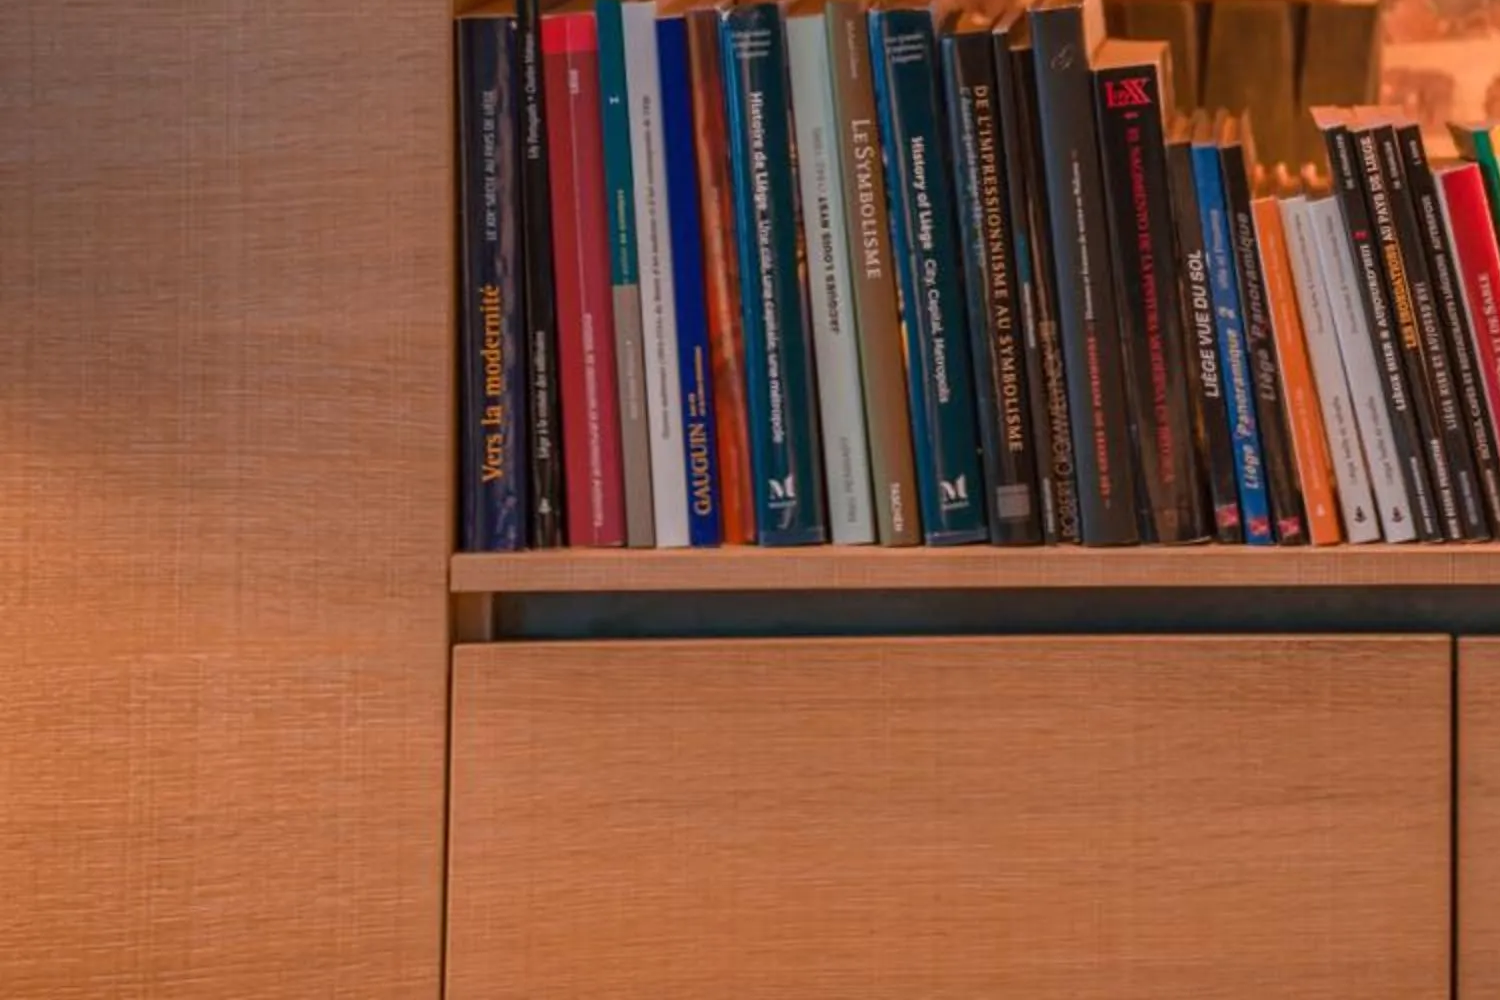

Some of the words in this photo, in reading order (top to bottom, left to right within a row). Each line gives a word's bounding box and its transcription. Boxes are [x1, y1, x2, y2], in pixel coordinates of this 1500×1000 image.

[974, 84, 990, 110] DE
[749, 90, 764, 148] Histoire
[753, 151, 767, 168] de
[911, 135, 925, 191] History
[754, 171, 768, 212] Liège
[917, 192, 931, 208] of
[978, 113, 1007, 299] L'IMPRESSIONNISME
[1373, 191, 1389, 224] PAYS
[855, 145, 881, 281] SYMBOLISME
[918, 209, 932, 251] Liège
[1380, 224, 1394, 242] AU
[1188, 248, 1205, 282] SOL
[995, 303, 1011, 330] AU
[1192, 283, 1208, 309] DU
[1218, 304, 1236, 321] 2
[480, 283, 501, 396] modernité
[1195, 310, 1213, 345] VUE
[933, 336, 949, 404] Metropolis
[1199, 348, 1220, 398] LIÈGE
[1258, 346, 1275, 402] Liège
[1000, 333, 1022, 453] SYMBOLISME
[482, 405, 504, 425] la
[482, 433, 505, 483] Vers
[689, 422, 711, 516] GAUGUIN
[1243, 442, 1259, 490] Liège
